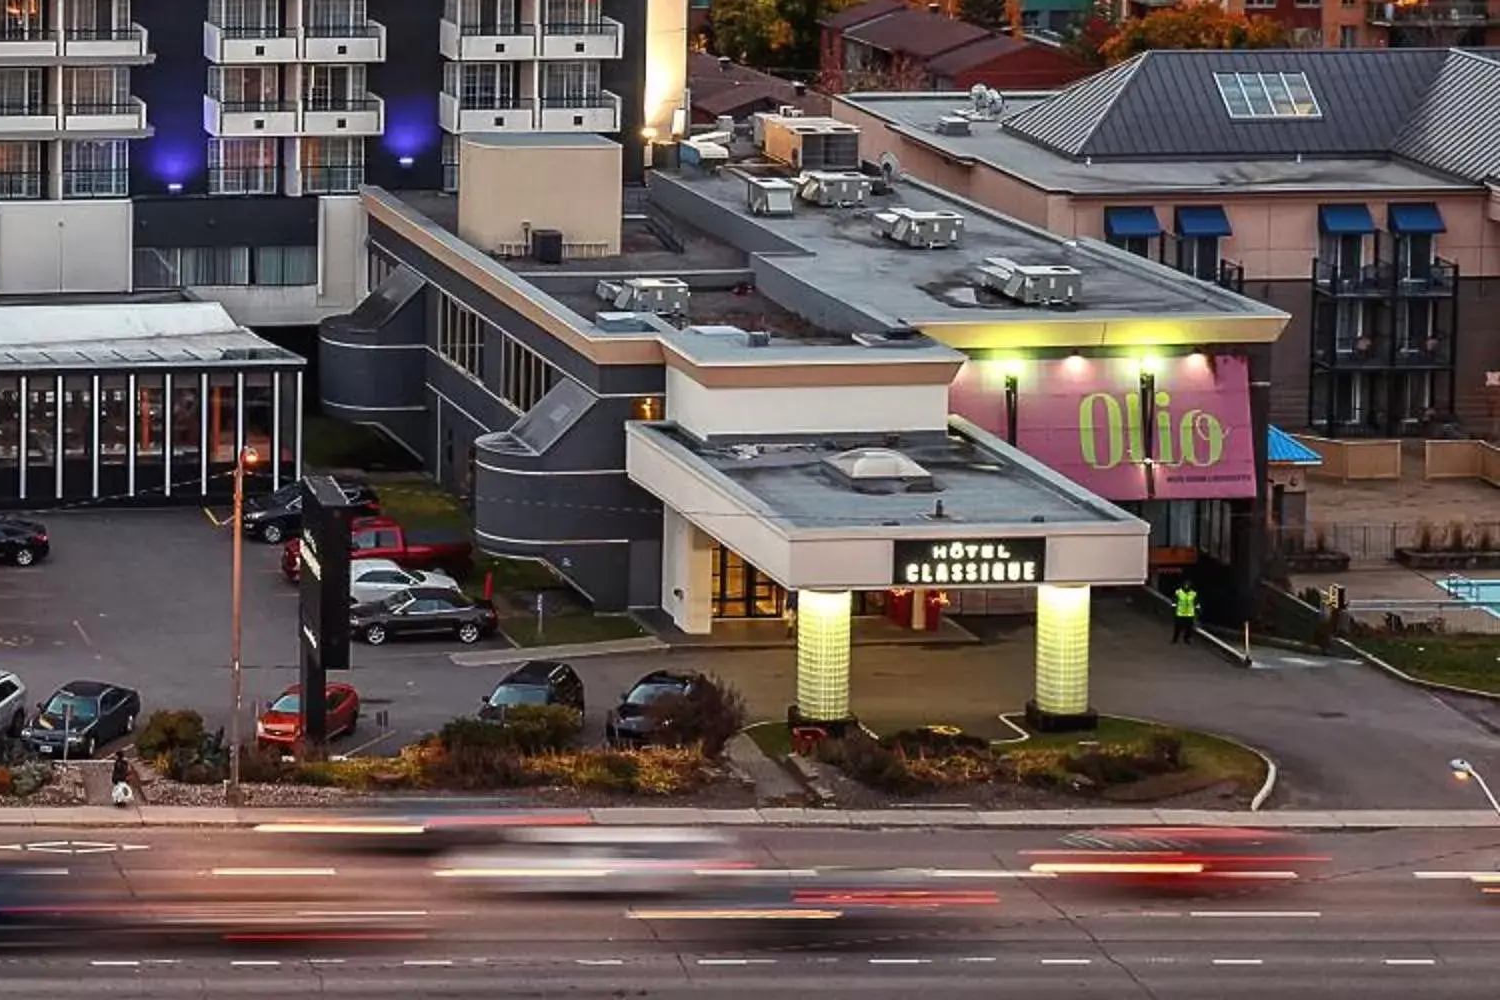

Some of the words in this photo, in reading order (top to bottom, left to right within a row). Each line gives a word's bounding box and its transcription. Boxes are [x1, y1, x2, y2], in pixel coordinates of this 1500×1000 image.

[1079, 392, 1227, 469] Olio
[932, 541, 1011, 560] HÔTEL
[906, 561, 1036, 582] CLASSIQUE
